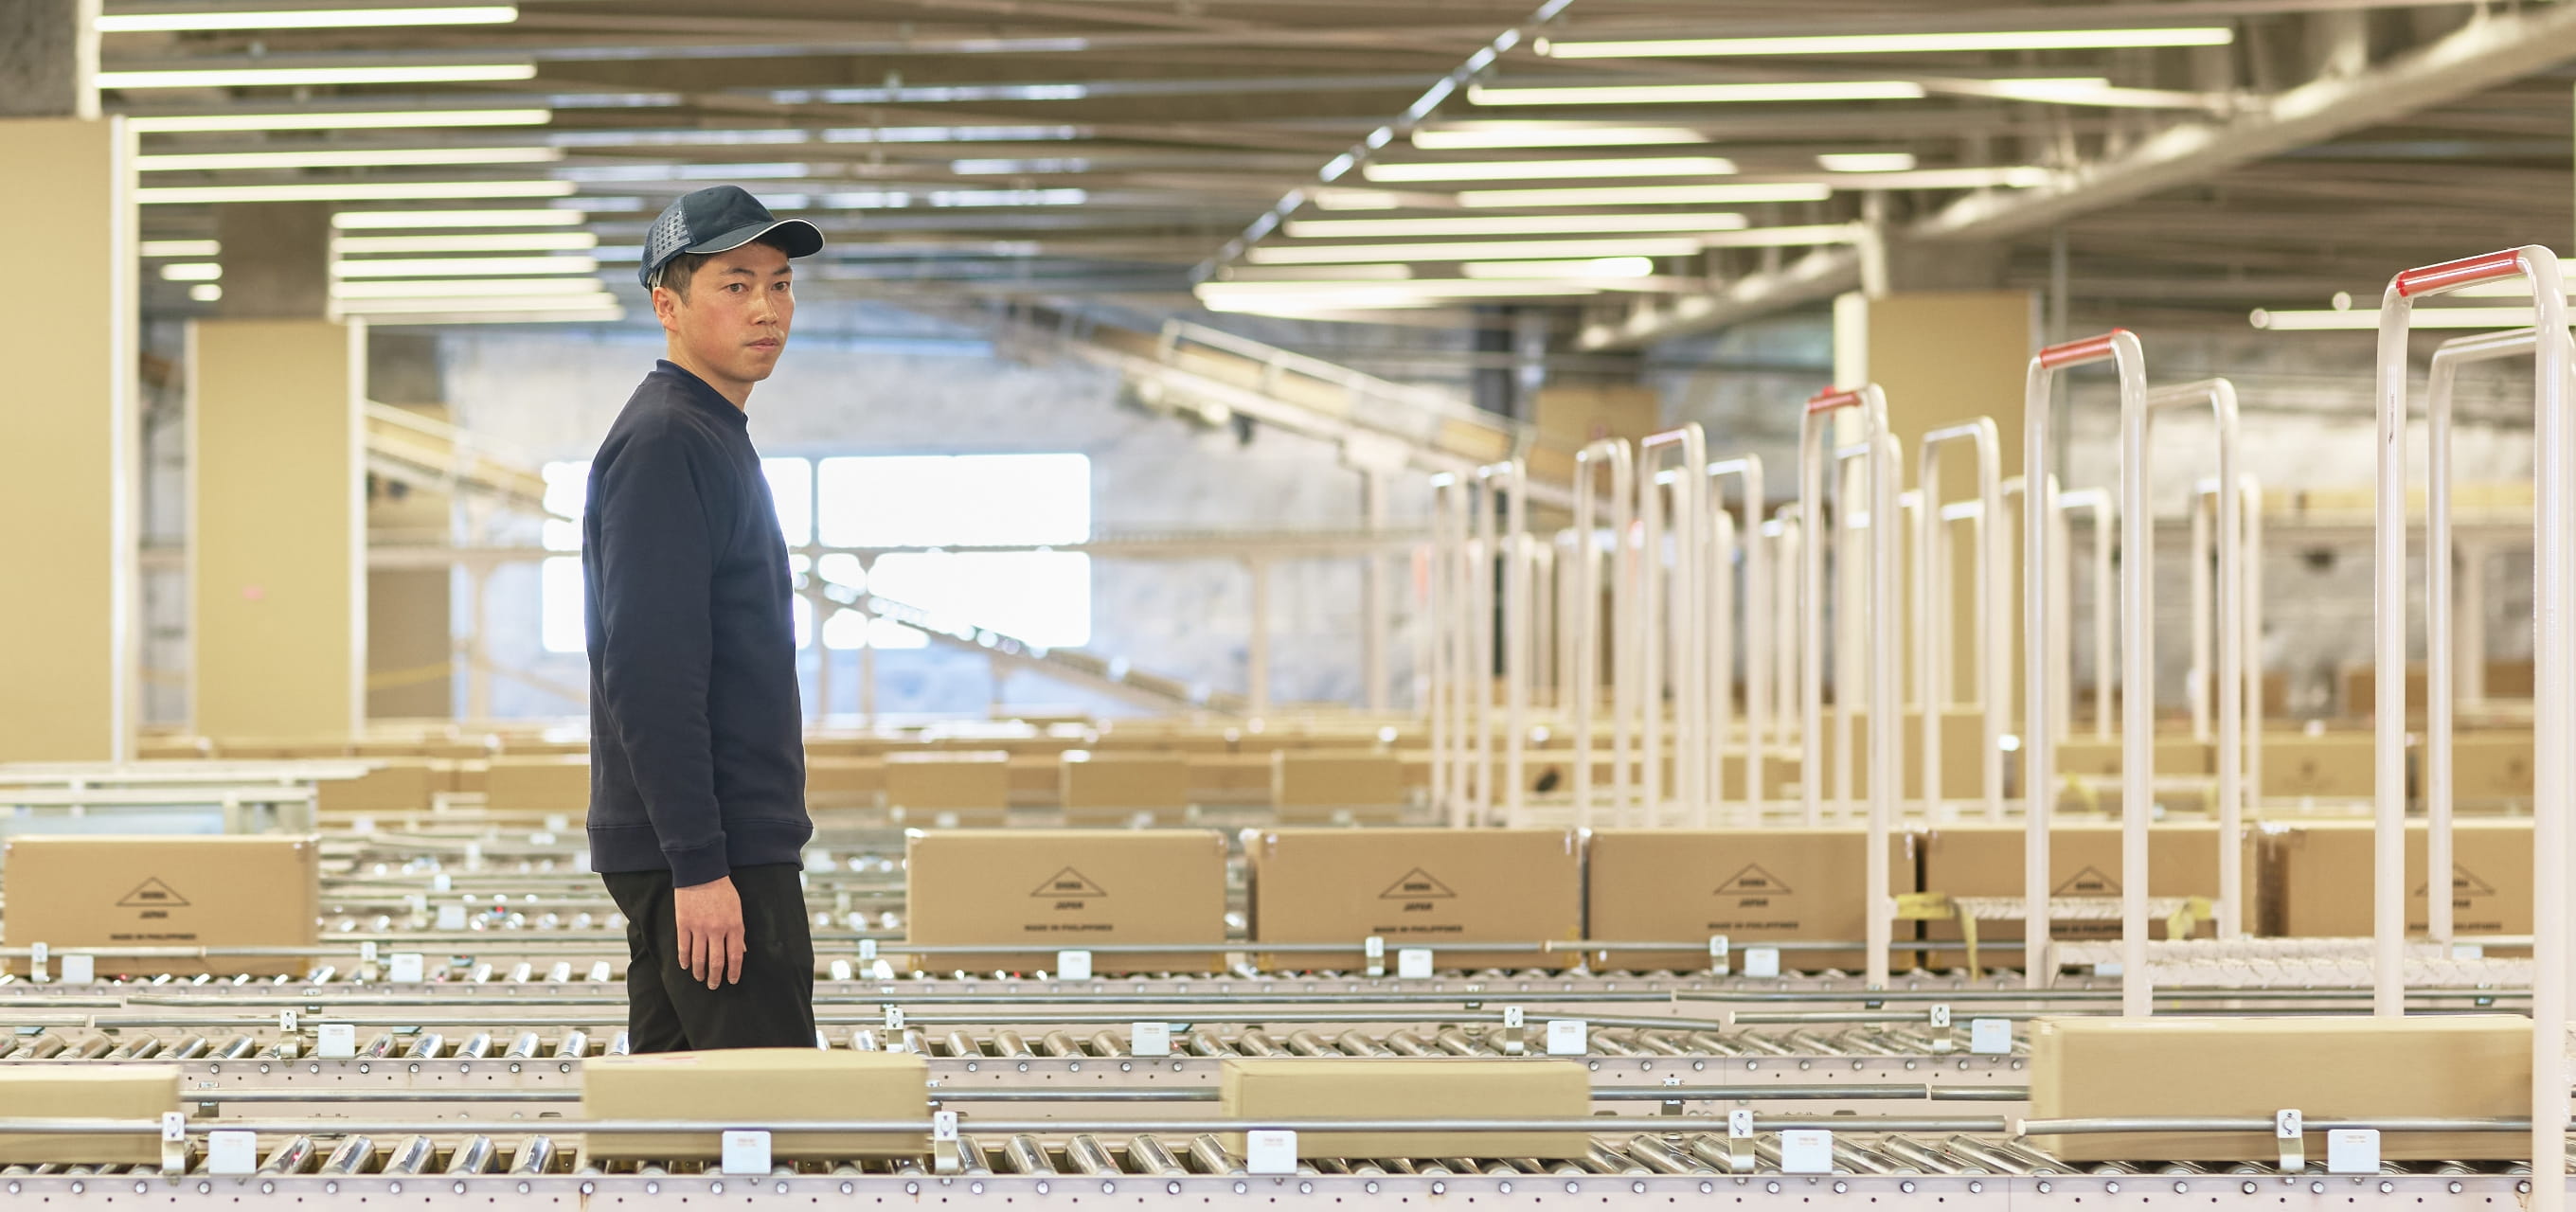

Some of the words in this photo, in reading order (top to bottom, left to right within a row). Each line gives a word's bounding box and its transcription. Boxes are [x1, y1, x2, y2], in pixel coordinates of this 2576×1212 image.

[1054, 901, 1084, 910] JAPAN
[1404, 902, 1433, 911] JAPAN
[1739, 899, 1768, 908] JAPAN
[138, 910, 169, 918] JAPAN
